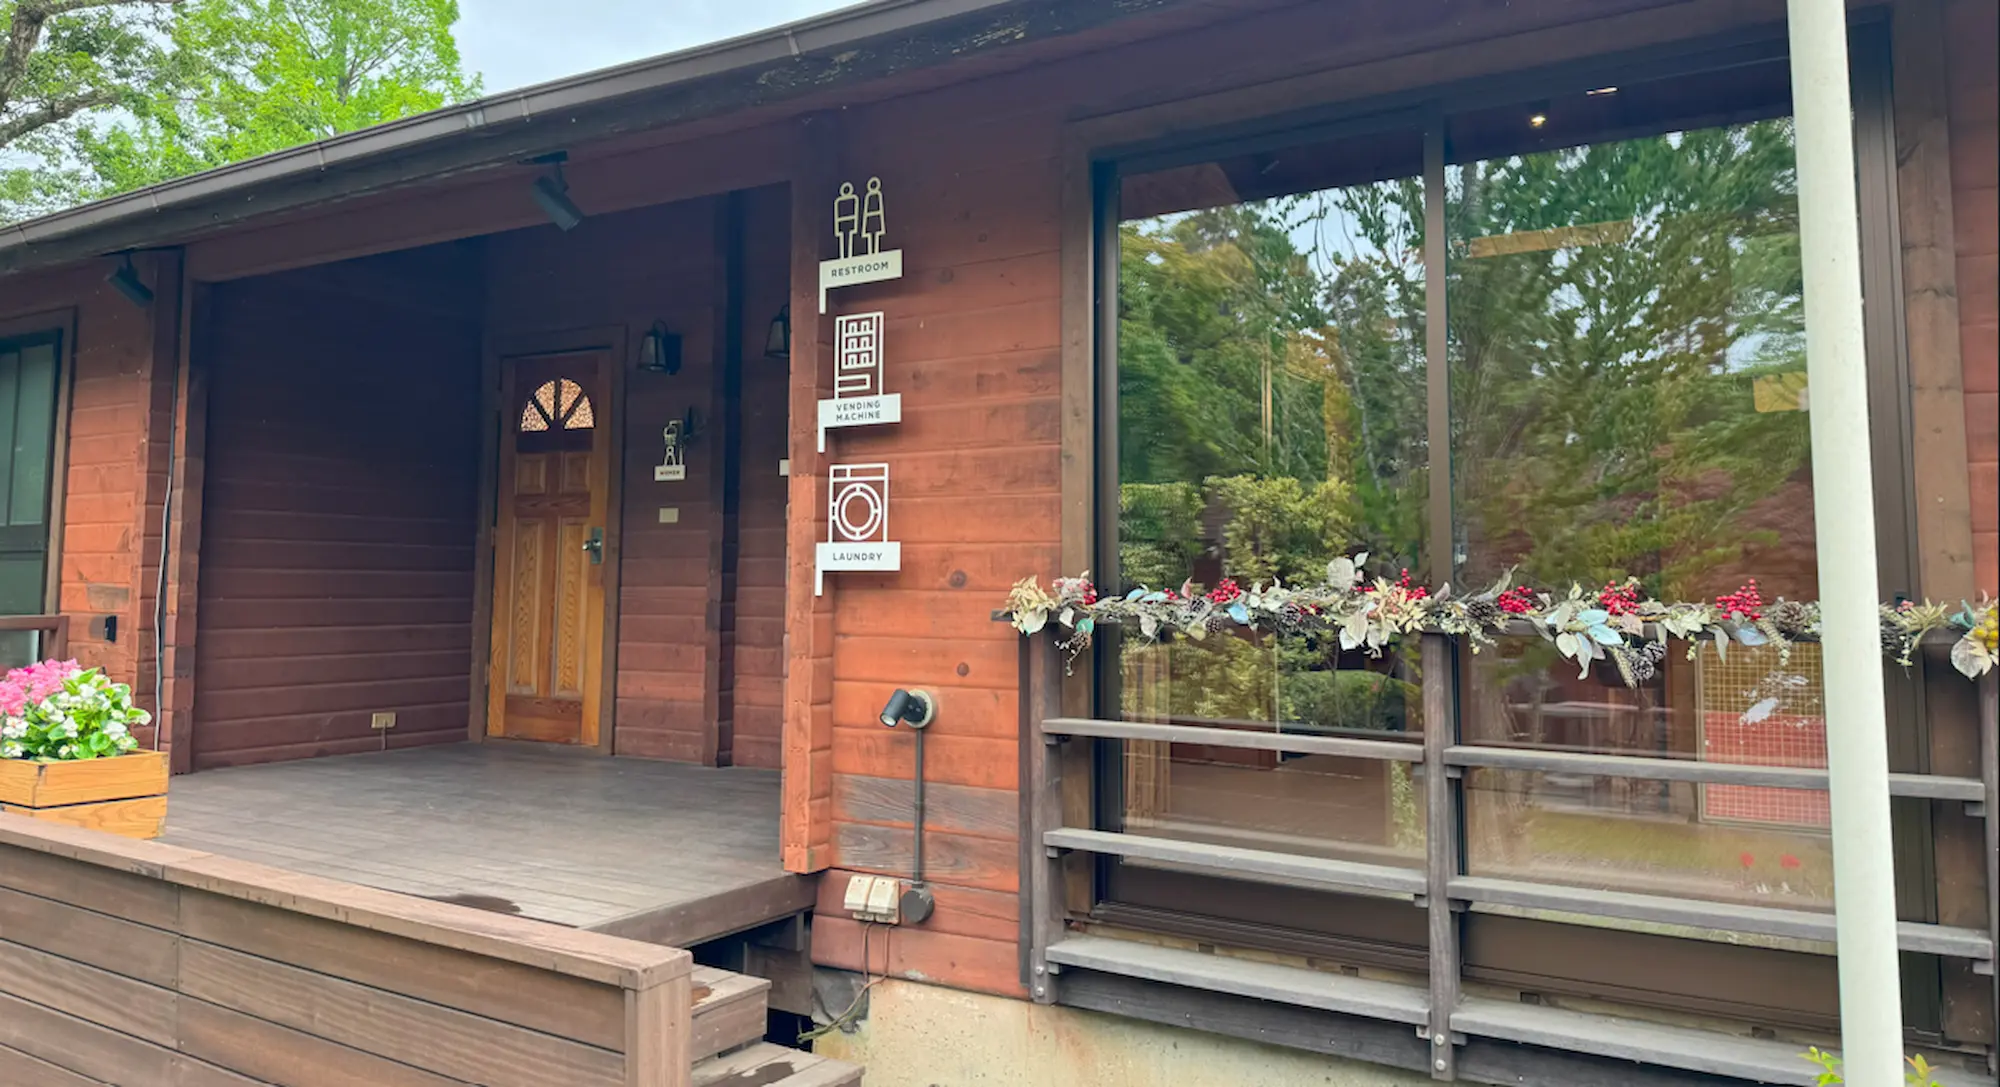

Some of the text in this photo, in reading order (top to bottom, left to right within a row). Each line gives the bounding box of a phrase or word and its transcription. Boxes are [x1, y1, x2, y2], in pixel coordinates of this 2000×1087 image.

[831, 261, 889, 277] RESTROOM
[836, 400, 881, 411] VENDING
[836, 410, 881, 422] MACHINE
[832, 552, 883, 561] LAUNDRY
